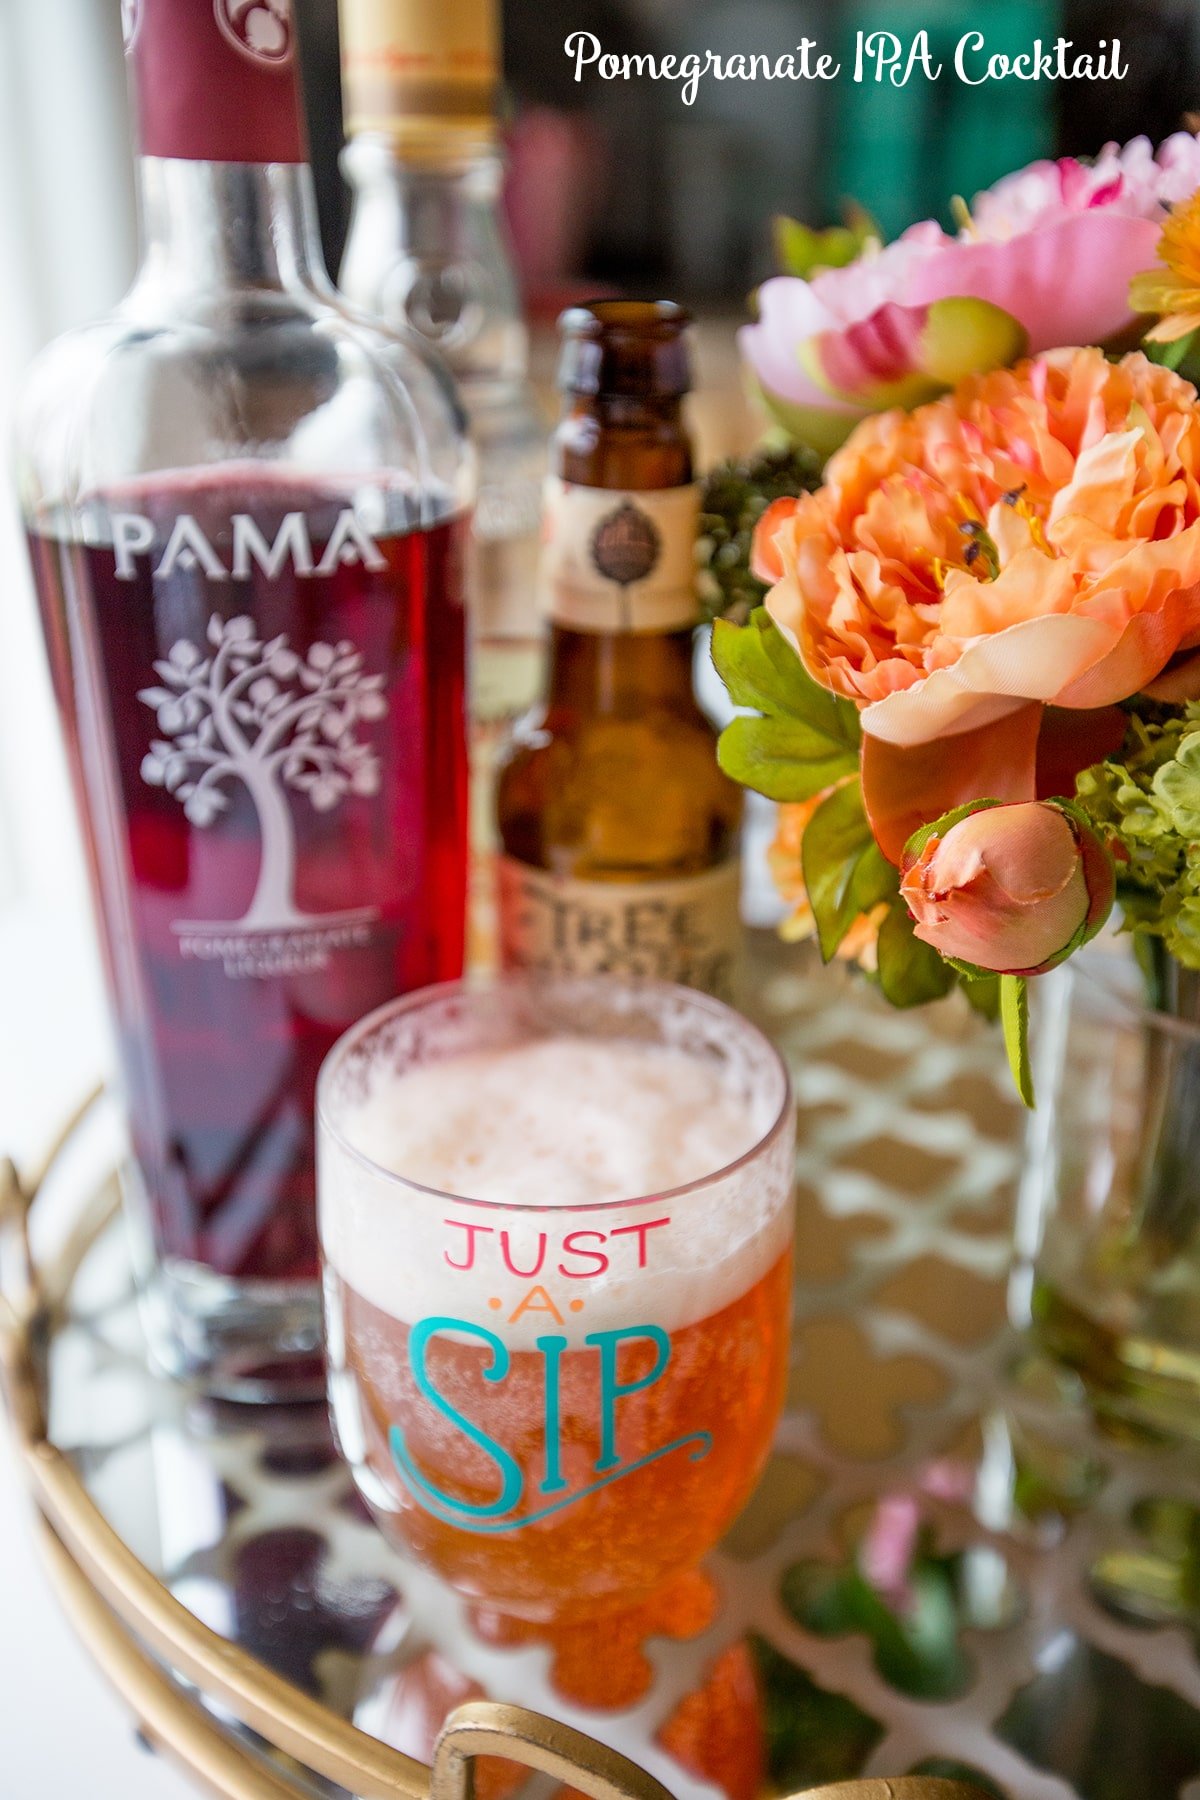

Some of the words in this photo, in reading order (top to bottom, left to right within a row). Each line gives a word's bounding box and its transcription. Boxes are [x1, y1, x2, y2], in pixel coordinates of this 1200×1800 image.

[110, 509, 388, 582] PAMA
[443, 1217, 671, 1279] JUST
[390, 1316, 672, 1518] SIP
